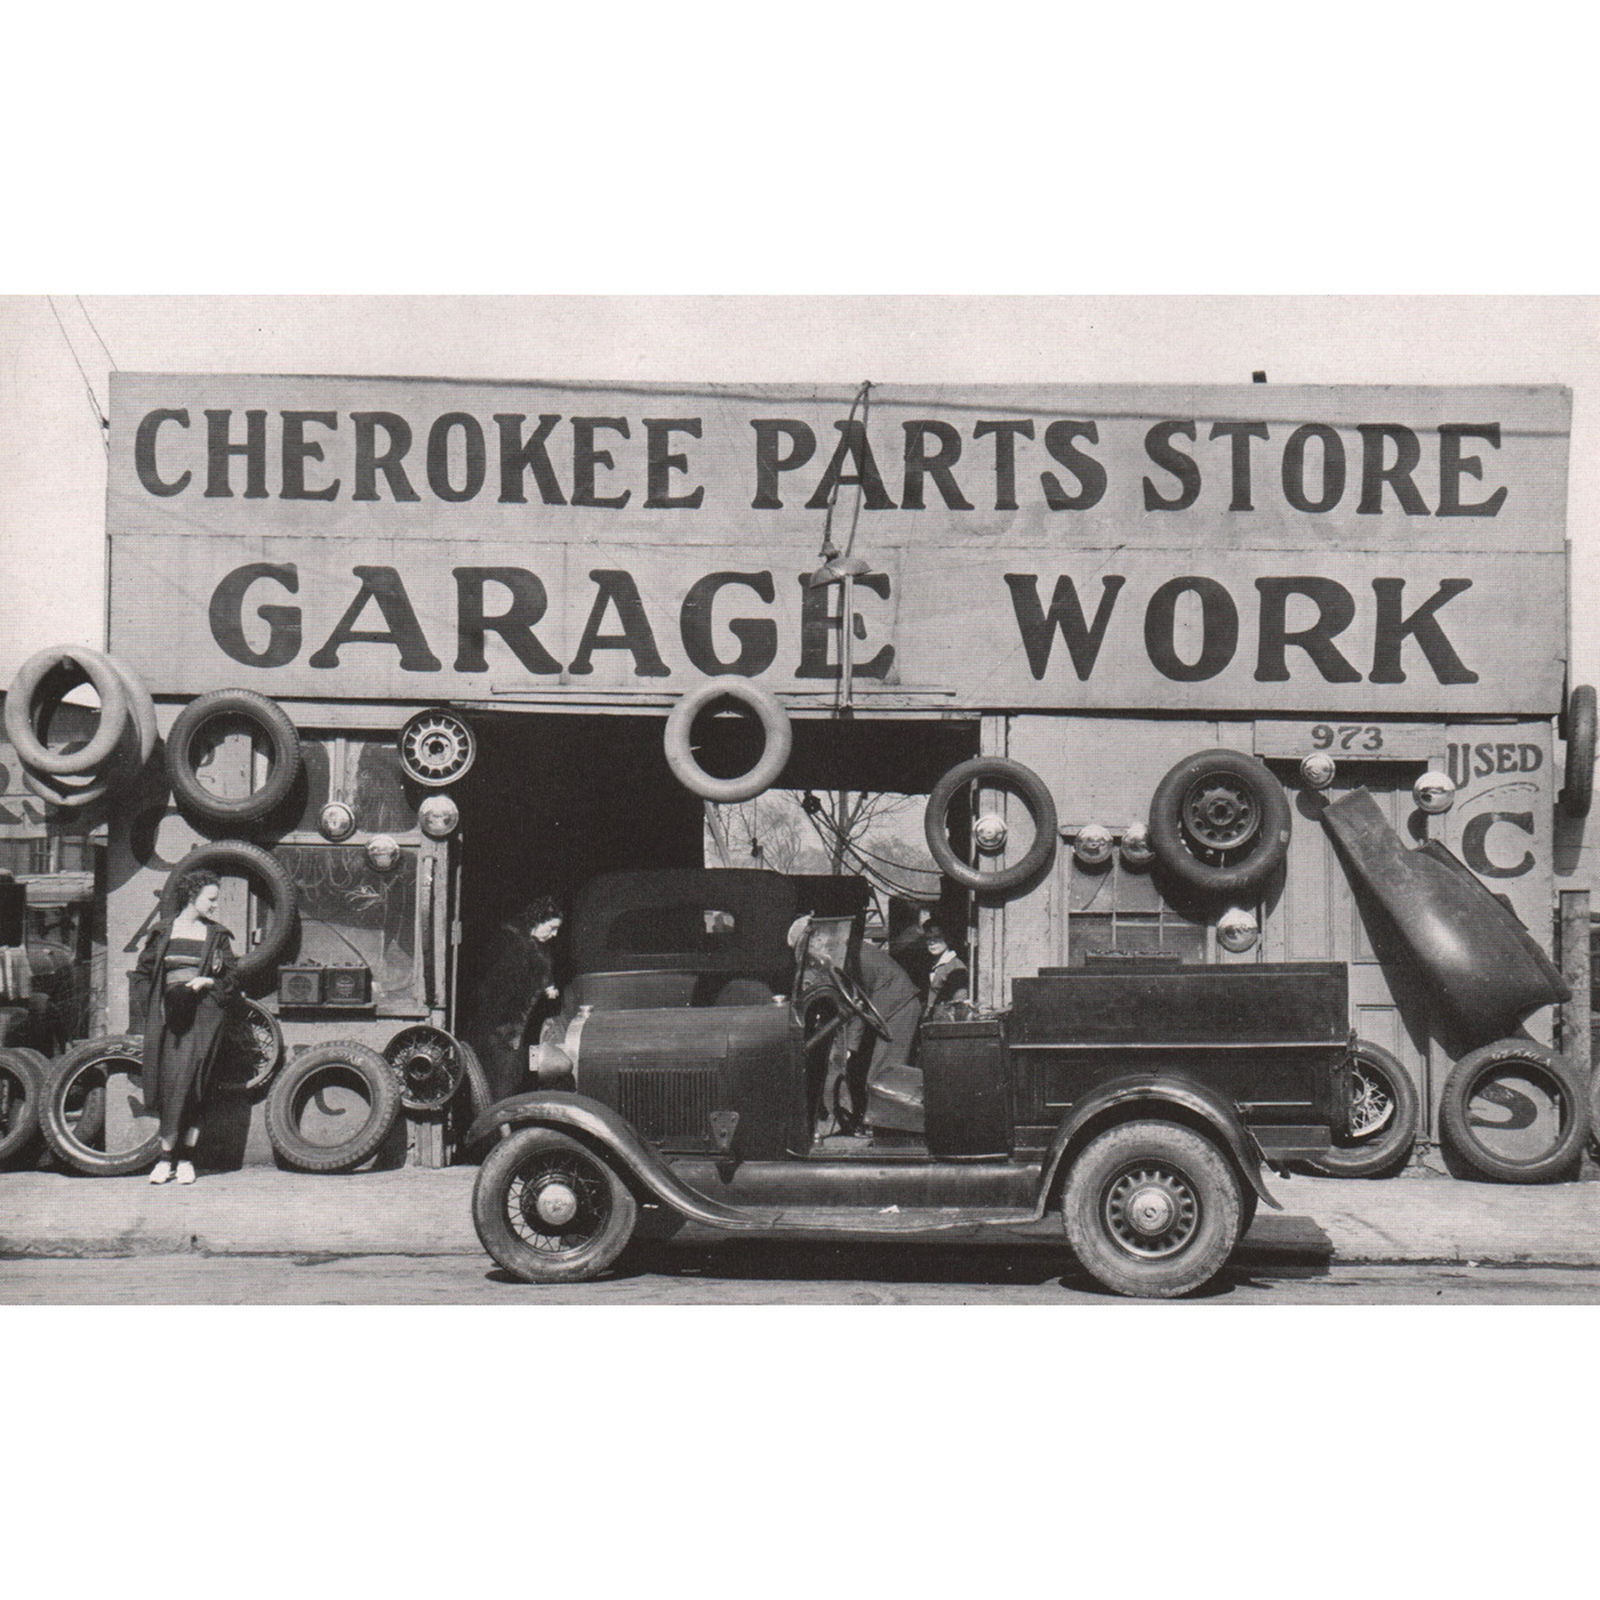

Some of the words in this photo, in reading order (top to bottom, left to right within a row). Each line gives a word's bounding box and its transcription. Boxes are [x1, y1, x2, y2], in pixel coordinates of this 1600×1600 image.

[134, 409, 704, 508] CHEROKEE
[751, 418, 1107, 511] PARTS
[1143, 420, 1508, 516] STORE
[209, 562, 895, 679] GARAGE
[1005, 574, 1479, 684] WORK
[1311, 724, 1383, 750] 973
[1447, 743, 1543, 789] USED
